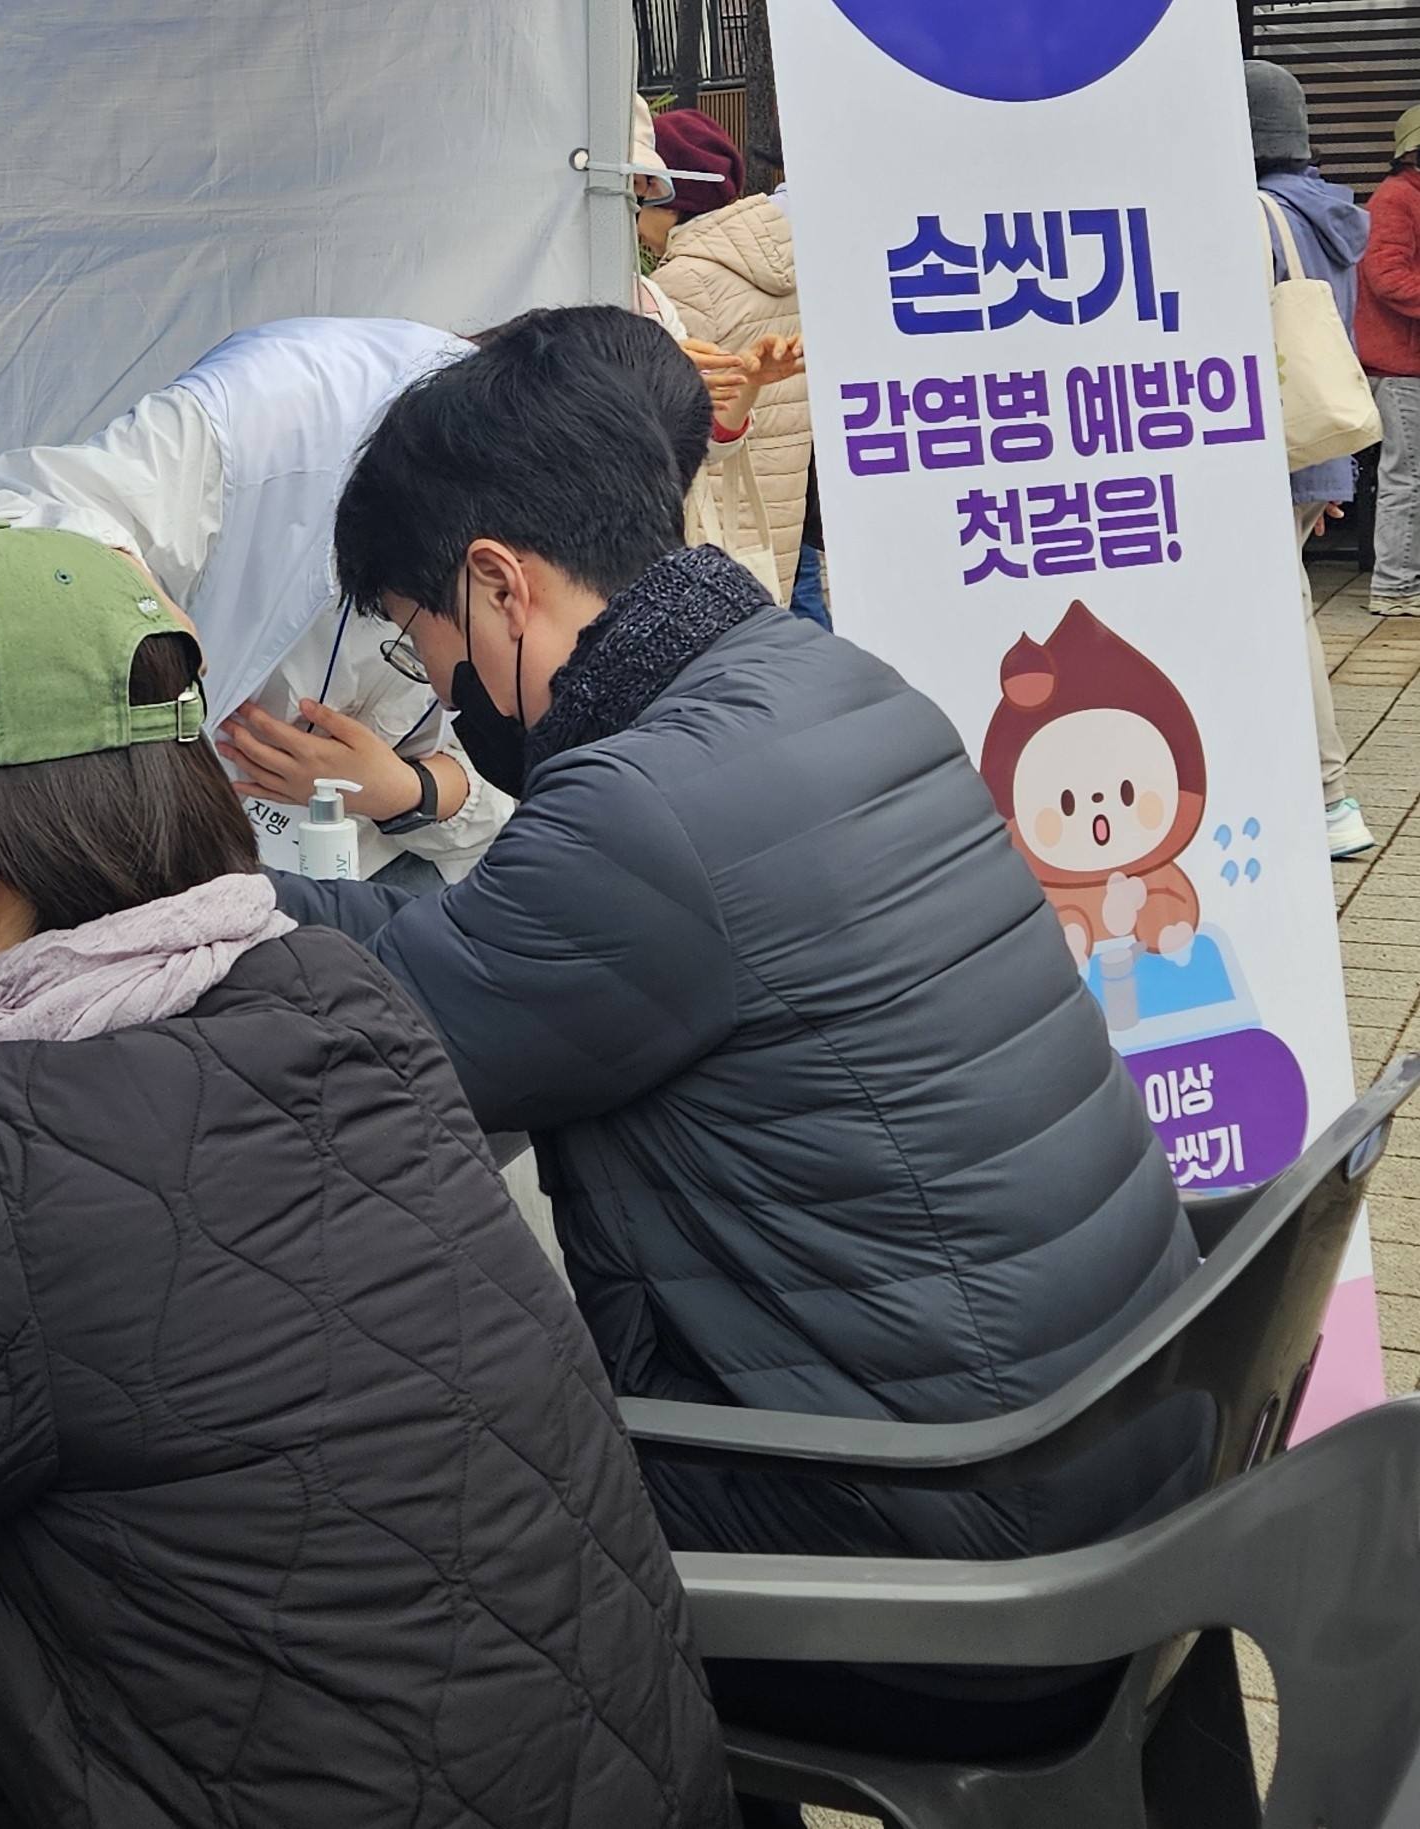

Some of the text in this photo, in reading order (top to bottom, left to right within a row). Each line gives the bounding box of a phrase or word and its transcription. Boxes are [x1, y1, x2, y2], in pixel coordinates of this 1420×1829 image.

[887, 208, 1179, 335] 손씻기,
[840, 355, 1266, 477] 감염병 예방의
[956, 474, 1182, 586] 첫걸음!
[248, 800, 290, 835] 진행
[1145, 1063, 1213, 1123] 이상
[1166, 1124, 1245, 1187] 씻기
